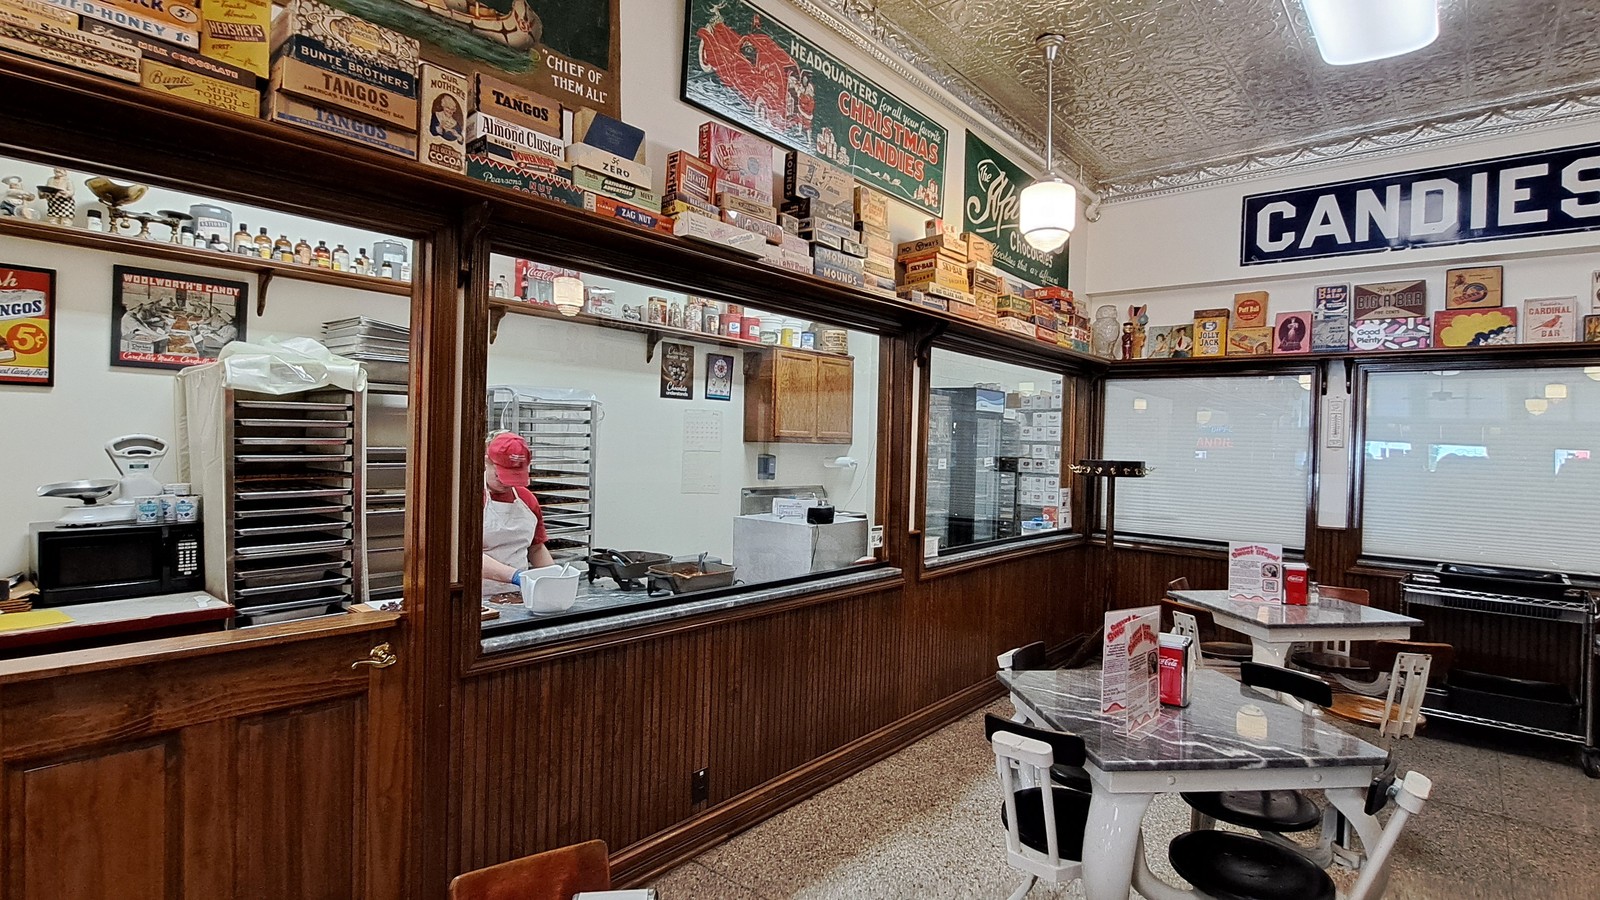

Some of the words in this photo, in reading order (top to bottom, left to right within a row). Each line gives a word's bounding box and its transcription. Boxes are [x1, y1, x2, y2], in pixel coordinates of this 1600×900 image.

[39, 22, 101, 46] Schutter
[207, 20, 263, 38] HERSHEY'S
[137, 40, 169, 57] MILK
[171, 51, 239, 79] CHOCOLATE
[300, 44, 342, 67] BUNTE
[347, 61, 410, 90] BROTHERS
[148, 69, 192, 84] Bunte
[440, 73, 459, 86] OUR
[587, 69, 603, 85] OF
[193, 88, 250, 109] TODDLE
[206, 85, 239, 99] MILK
[321, 72, 390, 108] TANGOS
[430, 79, 466, 101] MOTHER'S
[550, 74, 584, 96] THEM
[585, 86, 608, 104] ALL"
[790, 40, 879, 105] HEADQUARTERS
[879, 96, 893, 114] for
[891, 106, 903, 120] all
[902, 115, 920, 130] your
[918, 120, 942, 144] favorite
[207, 99, 237, 112] BAR
[491, 88, 549, 121] TANGOS
[314, 105, 388, 140] TANGOS
[837, 90, 939, 165] CHRISTMAS
[482, 115, 525, 145] Almond
[526, 131, 562, 158] Cluster
[429, 151, 463, 167] COCOA
[848, 125, 925, 182] CANDIES
[602, 162, 631, 179] ZERO
[667, 153, 679, 196] HEATH
[786, 151, 795, 198] MOUNDS
[979, 164, 993, 184] The
[482, 171, 523, 186] Pearson's
[528, 181, 553, 195] NUT
[1255, 154, 1600, 254] CANDIES
[621, 208, 637, 220] ZAG
[638, 213, 653, 225] NUT
[824, 249, 859, 269] MOUNDS
[910, 261, 934, 272] SKY-BAR
[123, 273, 203, 292] WOOLWORTH'S
[205, 284, 241, 297] CANDY
[823, 266, 858, 286] MOUNDS
[1356, 294, 1379, 310] BIG
[1383, 294, 1392, 307] A
[1395, 291, 1423, 307] BAR
[1528, 306, 1571, 316] CARDINAL
[13, 326, 46, 351] 5¢
[1198, 331, 1220, 340] JOLLY
[1356, 328, 1381, 336] Good
[1356, 337, 1383, 345] Plenty
[1541, 330, 1560, 338] BAR
[1199, 339, 1220, 347] JACK
[121, 351, 157, 362] Carefully
[10, 367, 33, 377] Candy
